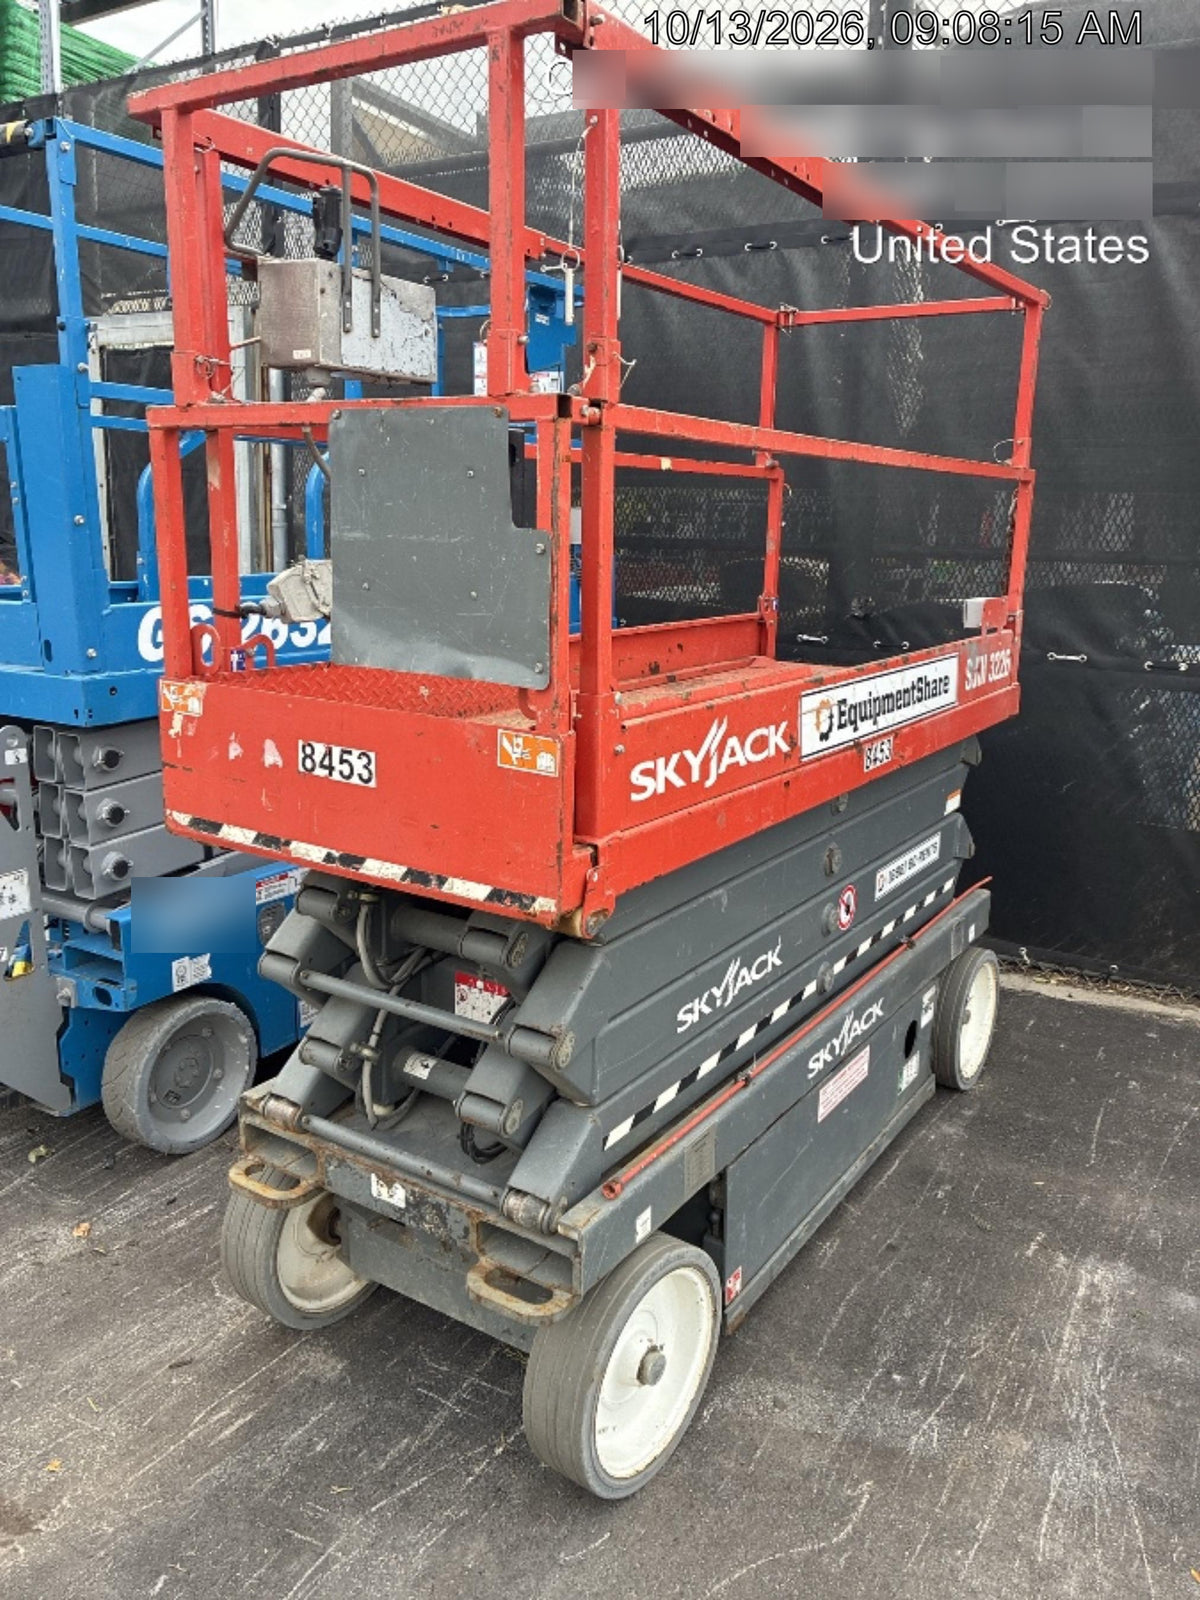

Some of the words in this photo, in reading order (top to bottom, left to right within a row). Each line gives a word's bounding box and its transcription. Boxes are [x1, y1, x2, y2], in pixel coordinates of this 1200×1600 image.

[837, 675, 950, 733] EquipmentShare
[301, 742, 373, 784] 8453
[629, 715, 791, 802] SKYJACK
[865, 738, 891, 769] 8453
[677, 935, 783, 1034] SKYJACK
[807, 997, 885, 1080] SKYJACK
